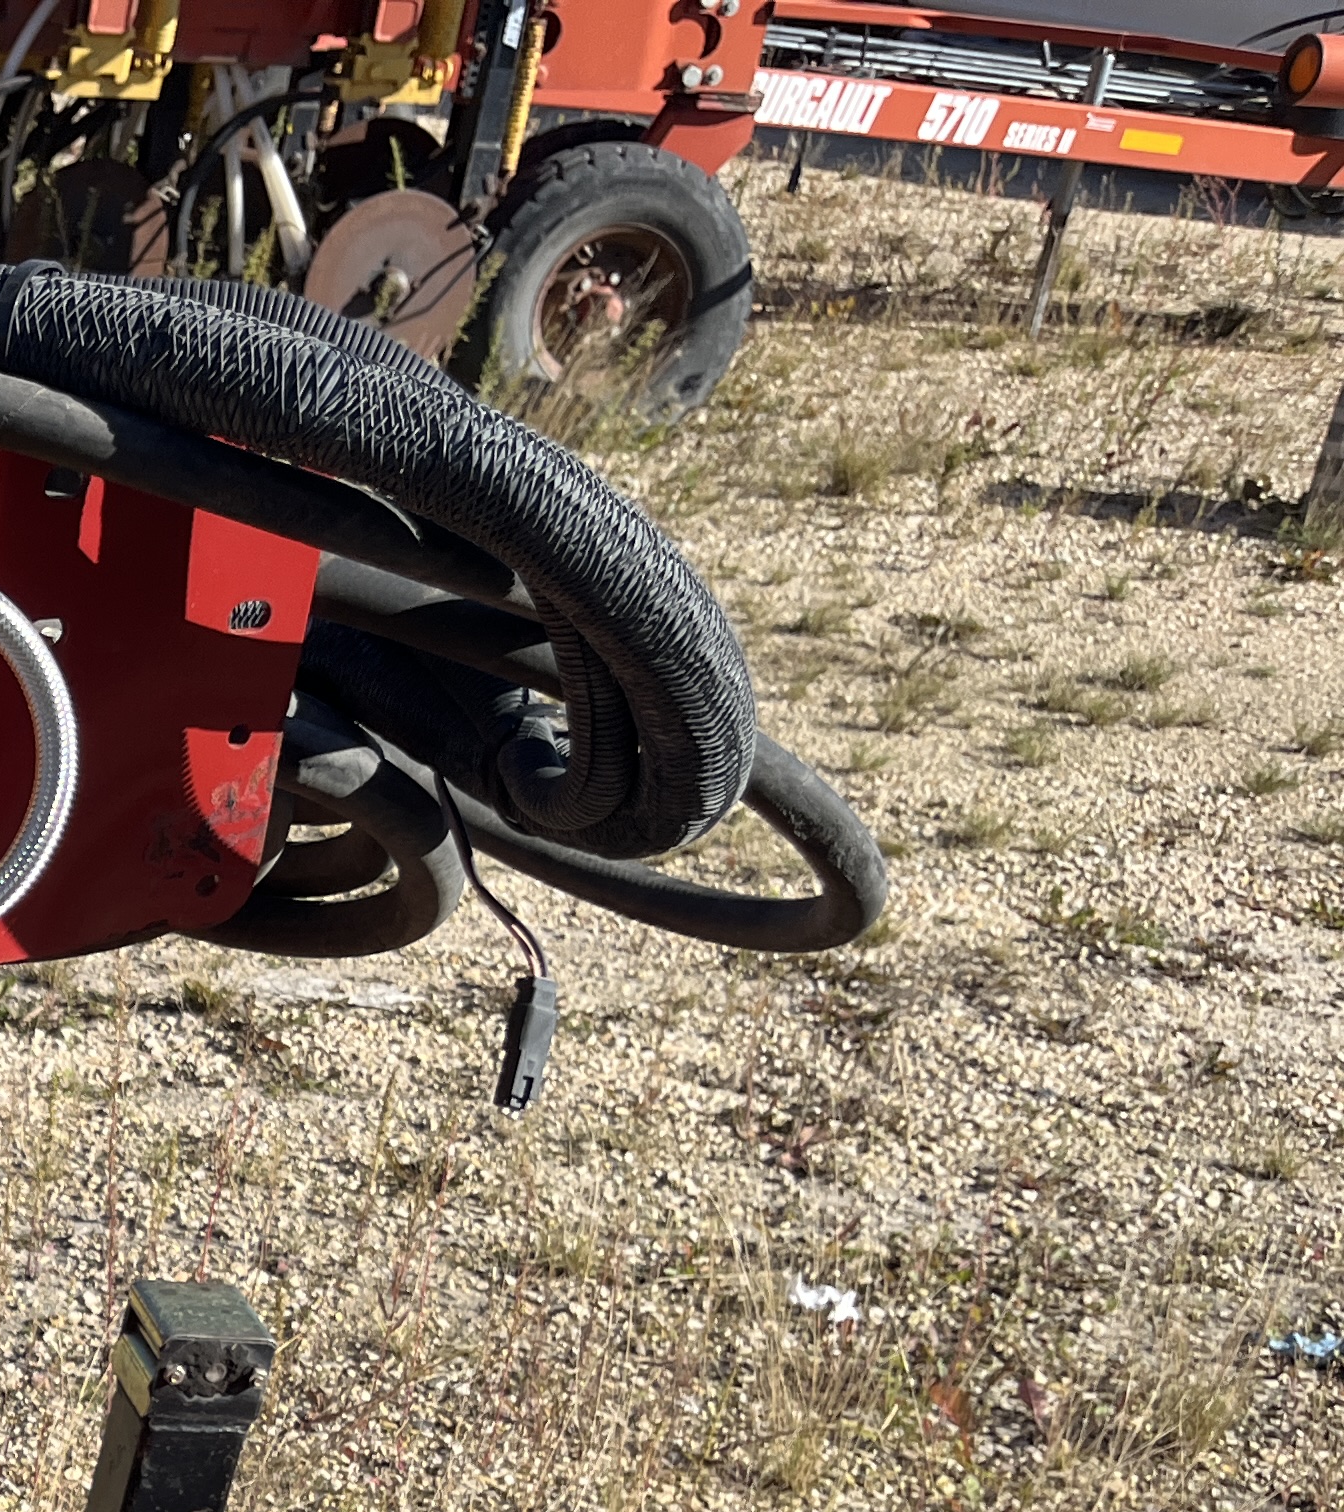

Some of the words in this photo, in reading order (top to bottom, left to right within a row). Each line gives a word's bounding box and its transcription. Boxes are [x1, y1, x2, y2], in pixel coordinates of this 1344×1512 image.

[917, 92, 1001, 146] 5710
[1003, 122, 1061, 153] SERIES
[1056, 128, 1077, 154] II
